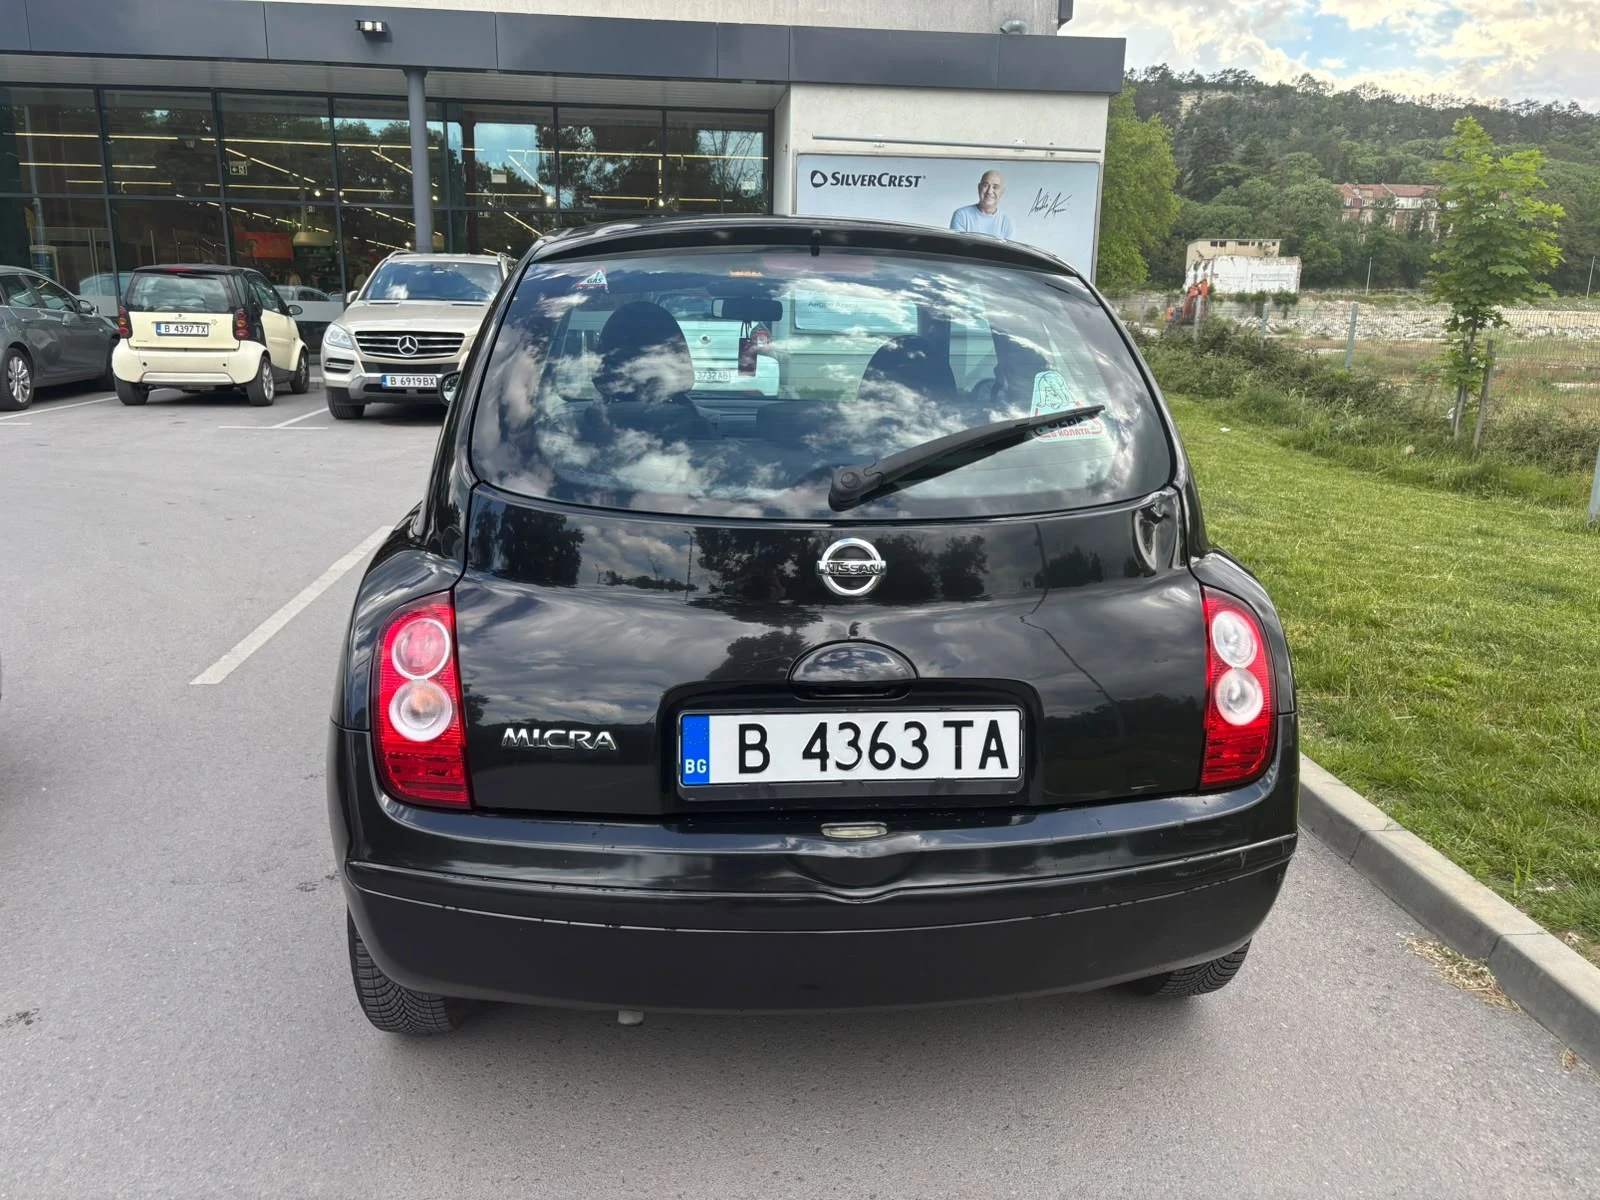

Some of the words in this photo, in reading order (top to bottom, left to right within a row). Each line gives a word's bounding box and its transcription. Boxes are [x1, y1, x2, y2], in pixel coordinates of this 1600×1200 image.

[164, 325, 170, 333] B
[174, 325, 194, 333] 4397
[196, 325, 206, 333] TX
[390, 376, 397, 386] B
[825, 563, 879, 574] NISSAN
[501, 727, 617, 751] MICRA
[738, 723, 771, 775] B
[802, 720, 930, 773] 4363
[943, 719, 1009, 771] TA
[684, 758, 708, 775] BG
